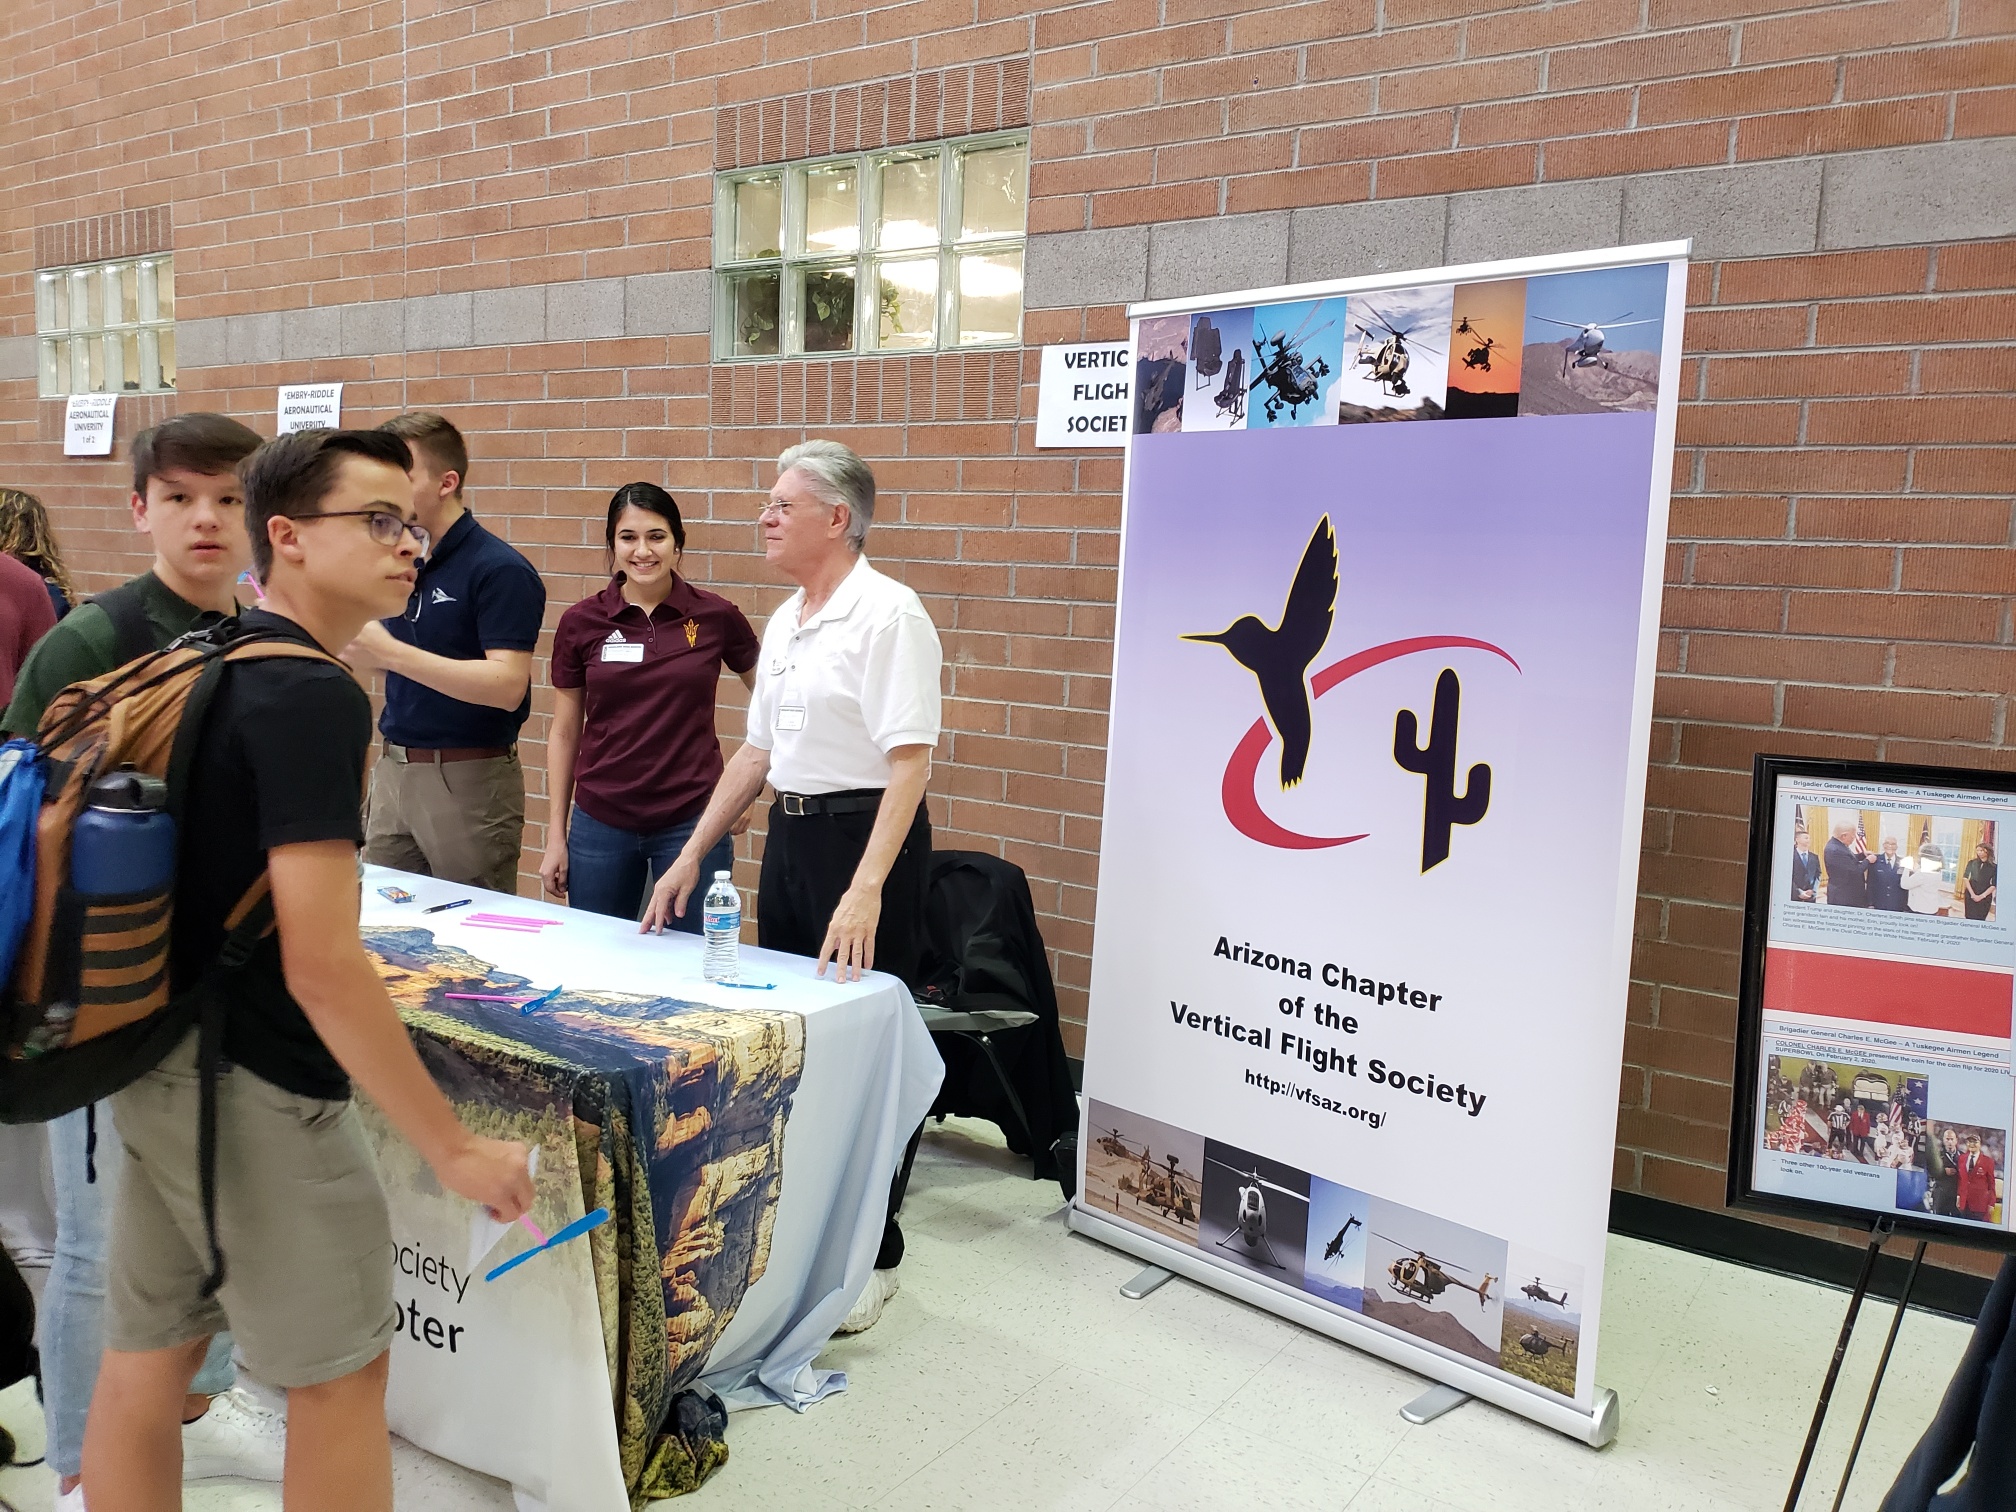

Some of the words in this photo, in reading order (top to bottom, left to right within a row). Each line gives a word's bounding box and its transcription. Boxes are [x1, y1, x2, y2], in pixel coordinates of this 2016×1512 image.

[1064, 350, 1129, 369] VERTIC
[1073, 383, 1129, 401] FLIGH
[284, 404, 332, 415] AERONAUTICAL
[1067, 416, 1127, 433] SOCIET
[1794, 780, 1822, 788] Brigadier
[1923, 791, 1954, 799] Tuskegee
[1213, 936, 1312, 980] Arizona
[1322, 963, 1443, 1012] Chapter
[1278, 996, 1306, 1018] of
[1314, 1002, 1358, 1034] the
[1811, 1029, 1836, 1037] General
[1912, 1042, 1945, 1051] Tuskegee
[1973, 1050, 1999, 1058] Legend
[1170, 1000, 1271, 1050] Vertical
[1280, 1032, 1358, 1077] Flight
[1368, 1059, 1487, 1117] Society
[1245, 1068, 1387, 1129] http://vfsaz.org/
